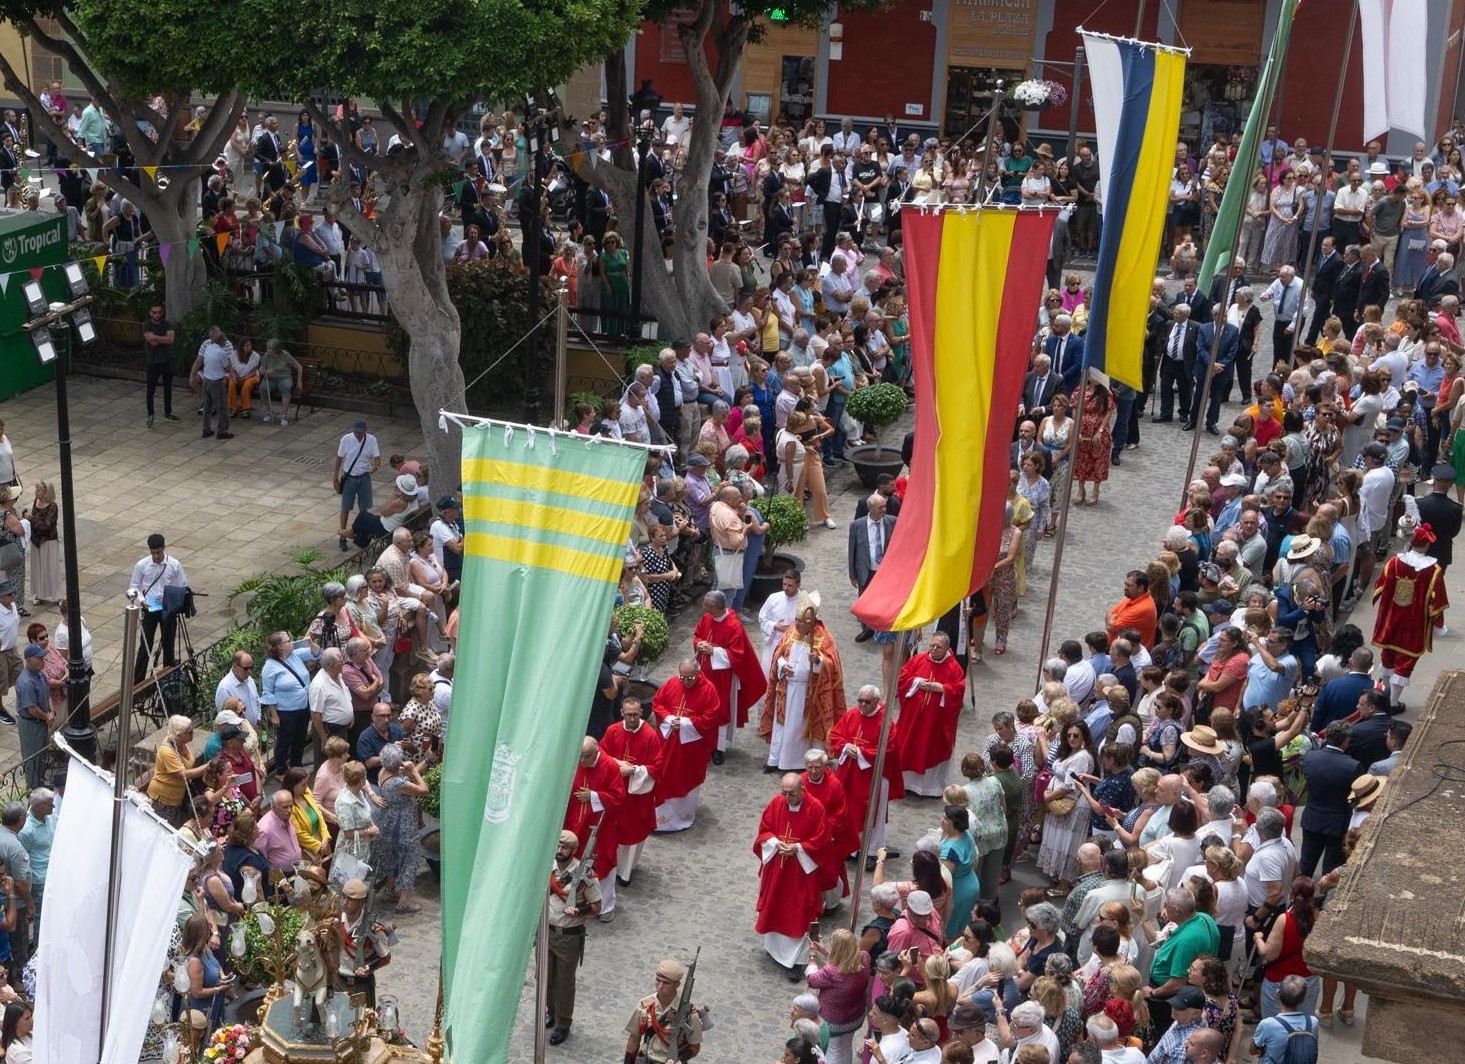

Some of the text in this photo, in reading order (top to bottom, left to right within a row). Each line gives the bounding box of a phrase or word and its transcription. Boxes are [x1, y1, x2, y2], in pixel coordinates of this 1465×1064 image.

[971, 10, 1030, 23] LA PLAZA
[18, 222, 61, 253] Tropical
